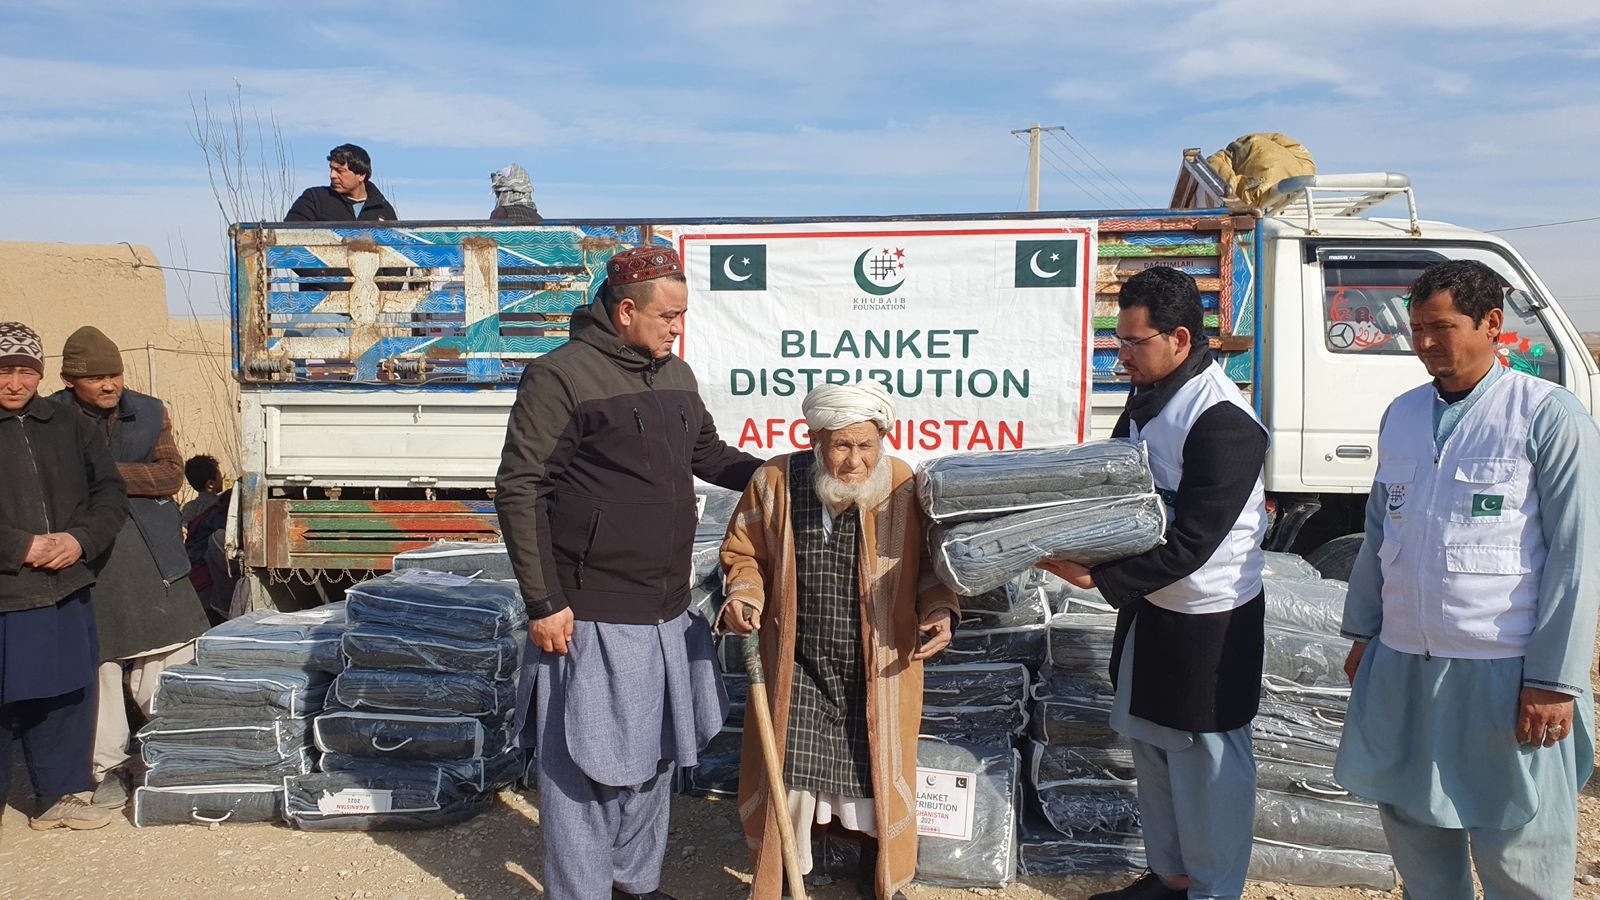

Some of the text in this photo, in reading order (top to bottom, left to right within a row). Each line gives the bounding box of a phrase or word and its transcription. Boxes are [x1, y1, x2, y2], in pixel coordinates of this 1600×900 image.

[781, 329, 980, 359] BLANKET
[738, 417, 1024, 451] AFGNISTAN
[916, 792, 949, 802] LANKET
[920, 817, 935, 825] 2021
